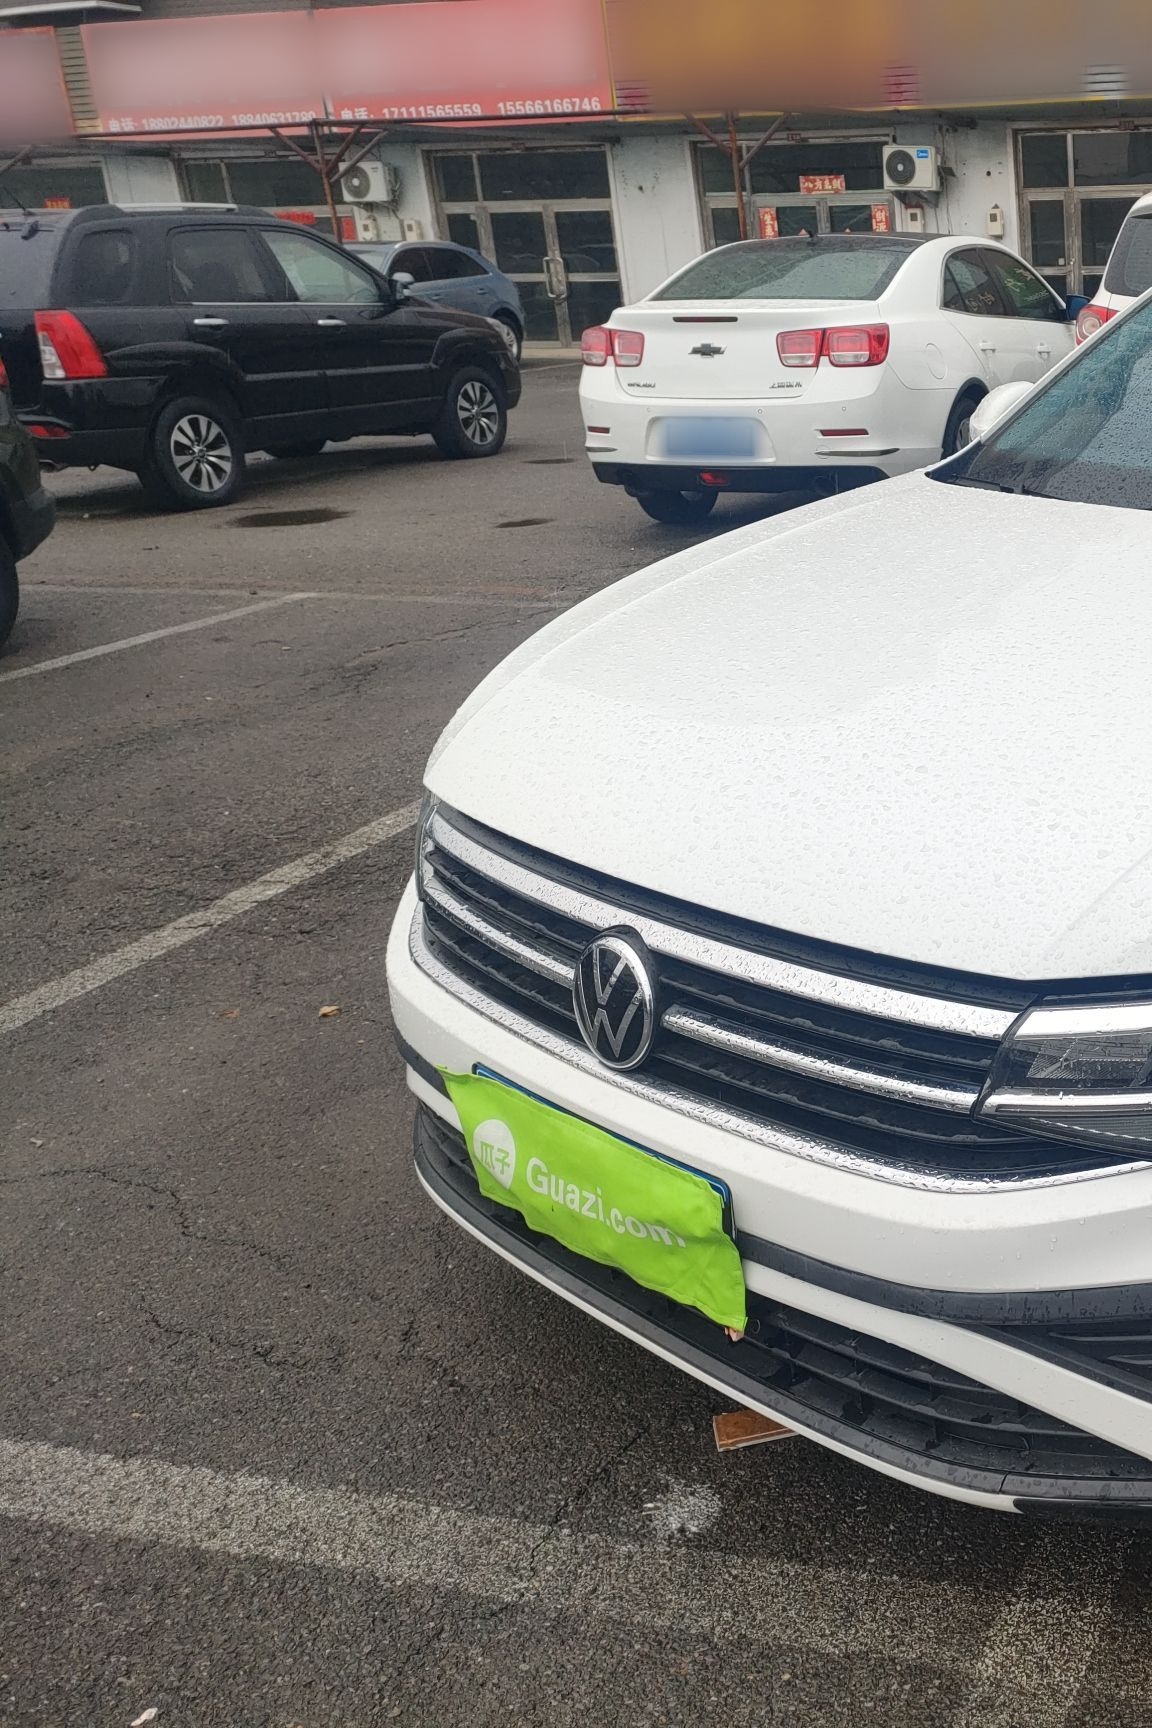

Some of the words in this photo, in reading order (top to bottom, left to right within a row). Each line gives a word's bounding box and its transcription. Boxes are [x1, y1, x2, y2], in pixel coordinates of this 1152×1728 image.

[498, 97, 601, 116] 15566166746
[479, 1140, 511, 1176] 瓜子
[525, 1156, 687, 1249] Guazi.com
